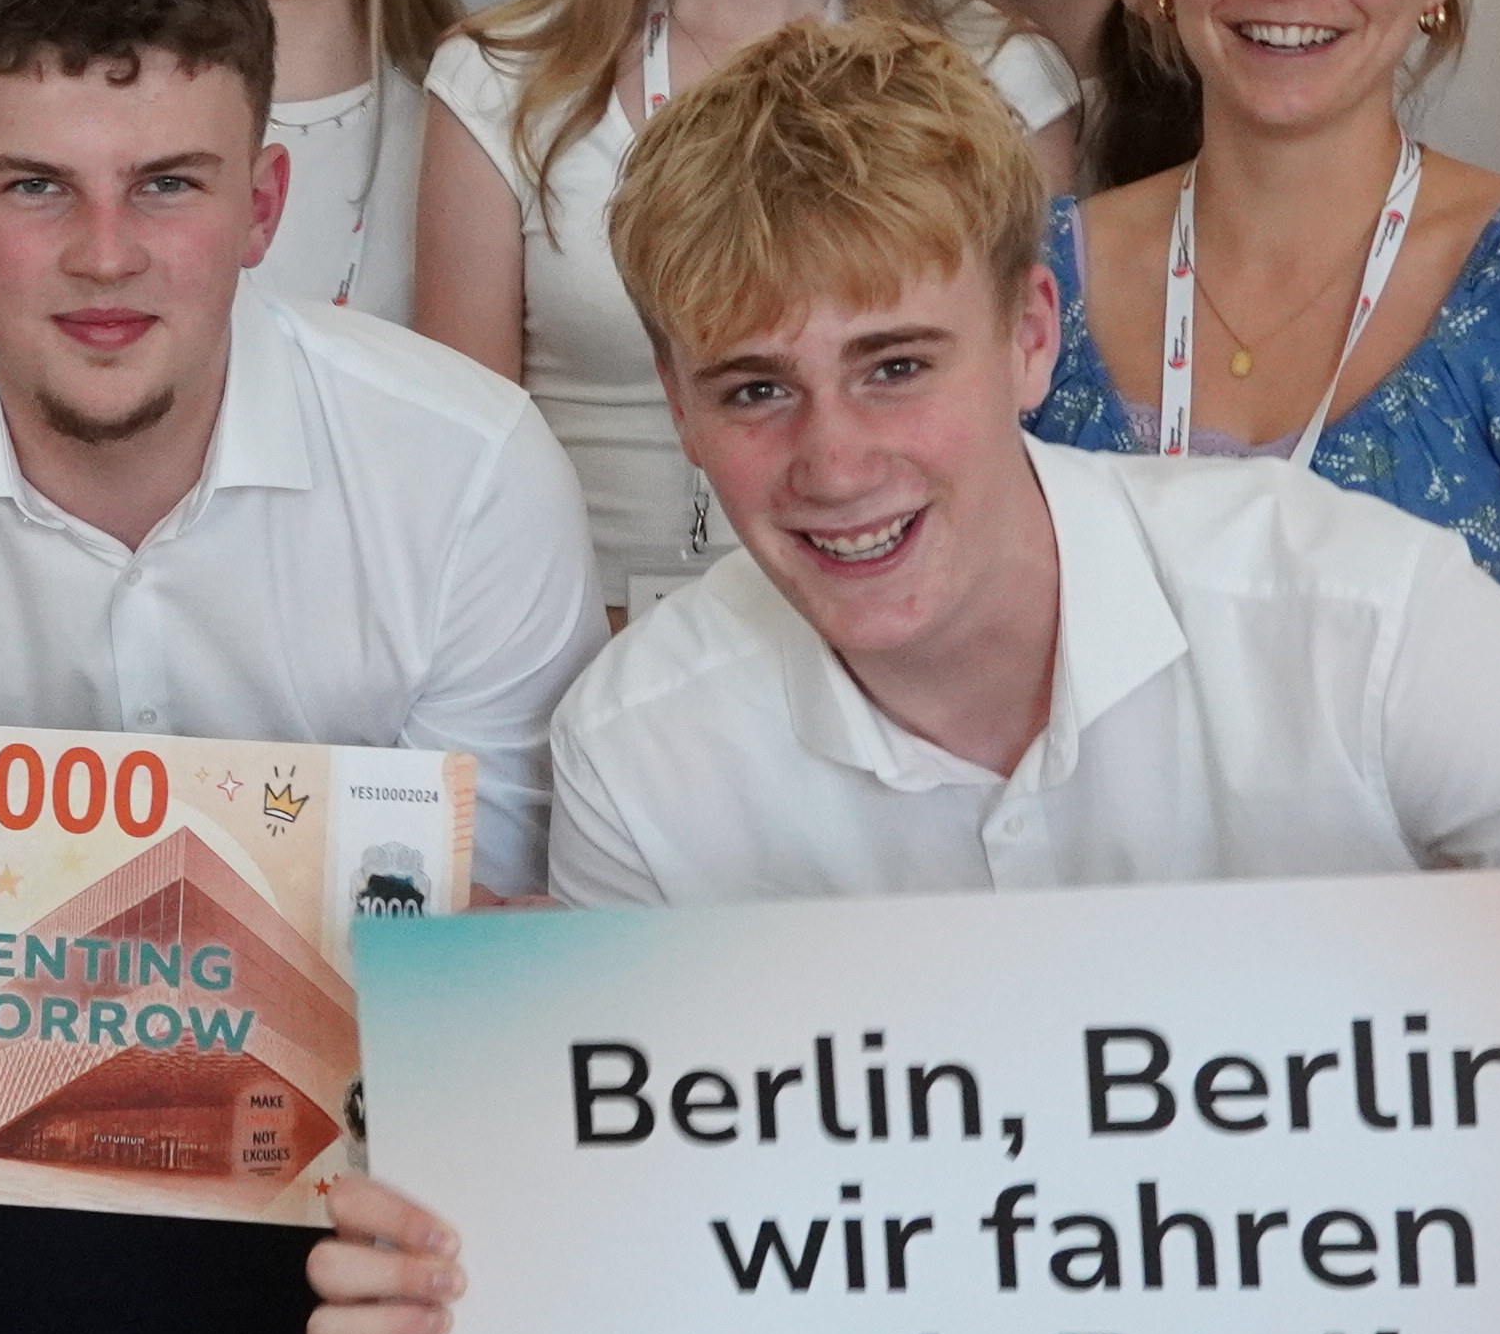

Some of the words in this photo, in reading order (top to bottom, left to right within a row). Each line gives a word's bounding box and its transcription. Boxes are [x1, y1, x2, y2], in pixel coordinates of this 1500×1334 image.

[250, 1094, 285, 1109] MAKE
[567, 1030, 1027, 1159] Berlin,
[252, 1130, 278, 1146] NOT
[242, 1148, 291, 1163] EXCUSES
[709, 1183, 934, 1293] wir
[980, 1180, 1478, 1292] fahren
